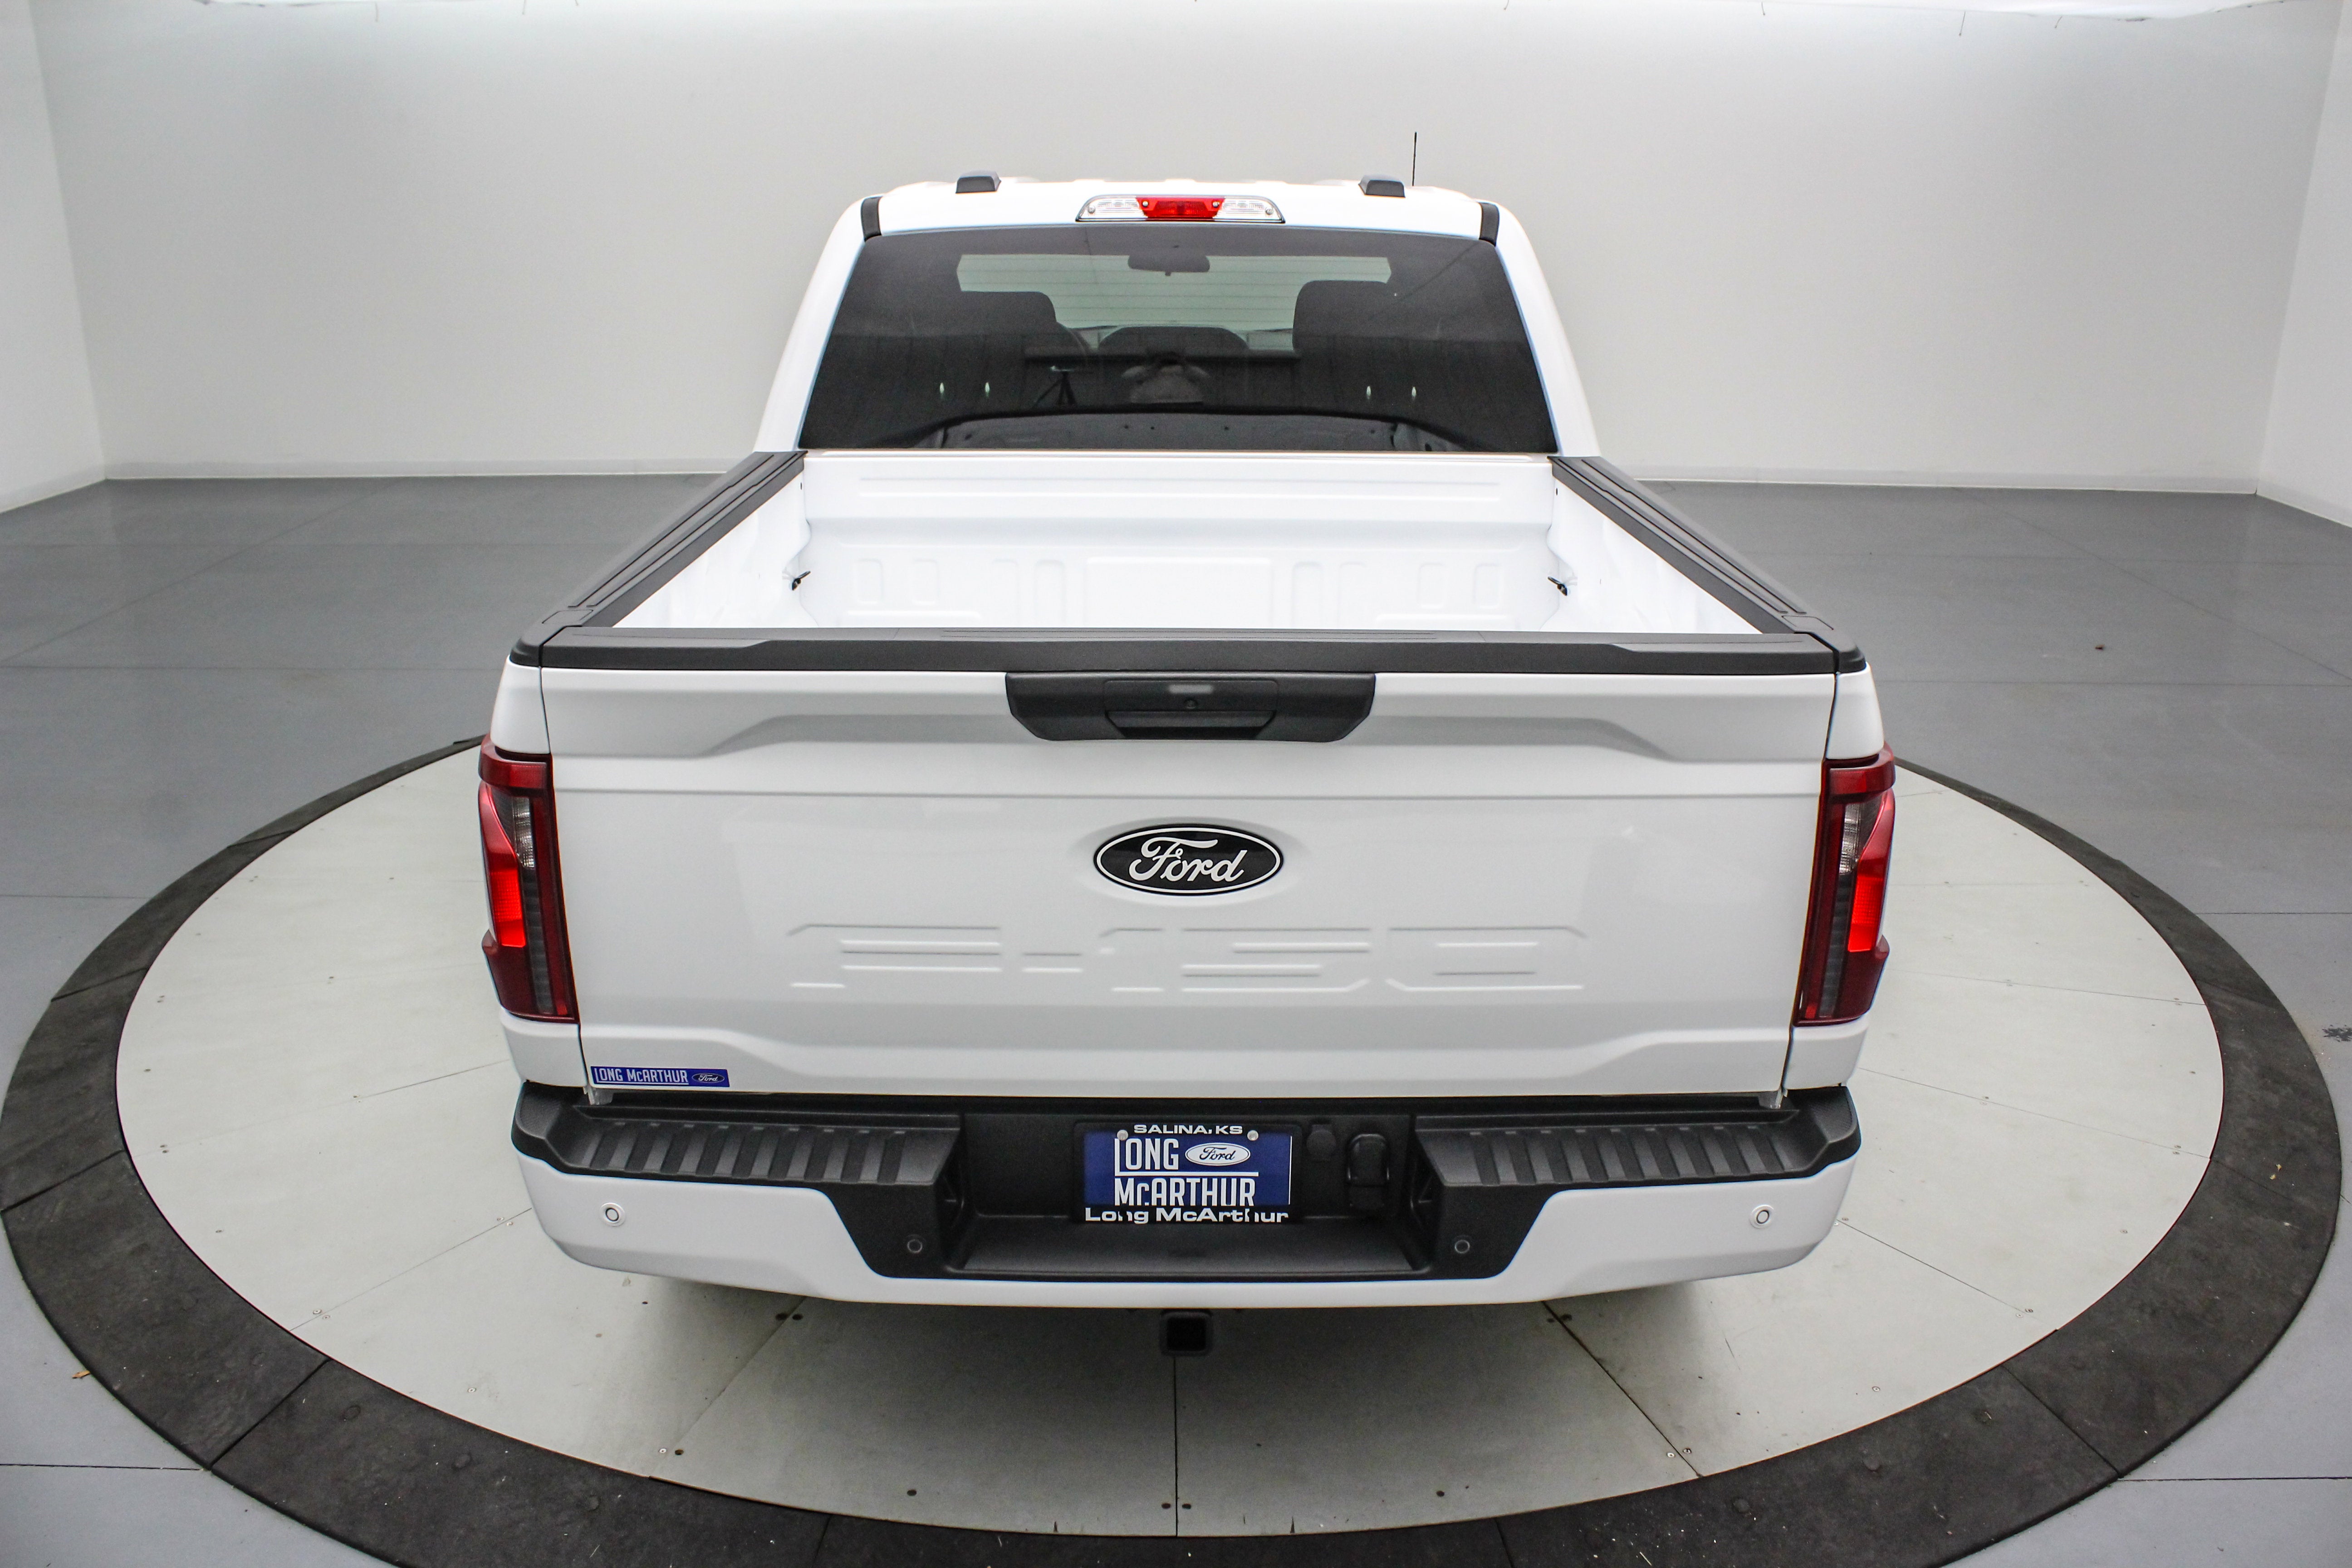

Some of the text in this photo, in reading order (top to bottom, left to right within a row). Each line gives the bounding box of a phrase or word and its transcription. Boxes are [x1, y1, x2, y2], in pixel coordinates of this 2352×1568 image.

[1129, 837, 1248, 882] Ford
[594, 1068, 688, 1083] LONG McARTHUR
[1134, 1125, 1243, 1134] SALINA, KS
[1114, 1137, 1179, 1176] LONG
[1199, 1146, 1236, 1160] Ford
[1114, 1177, 1255, 1206] McARTHUR
